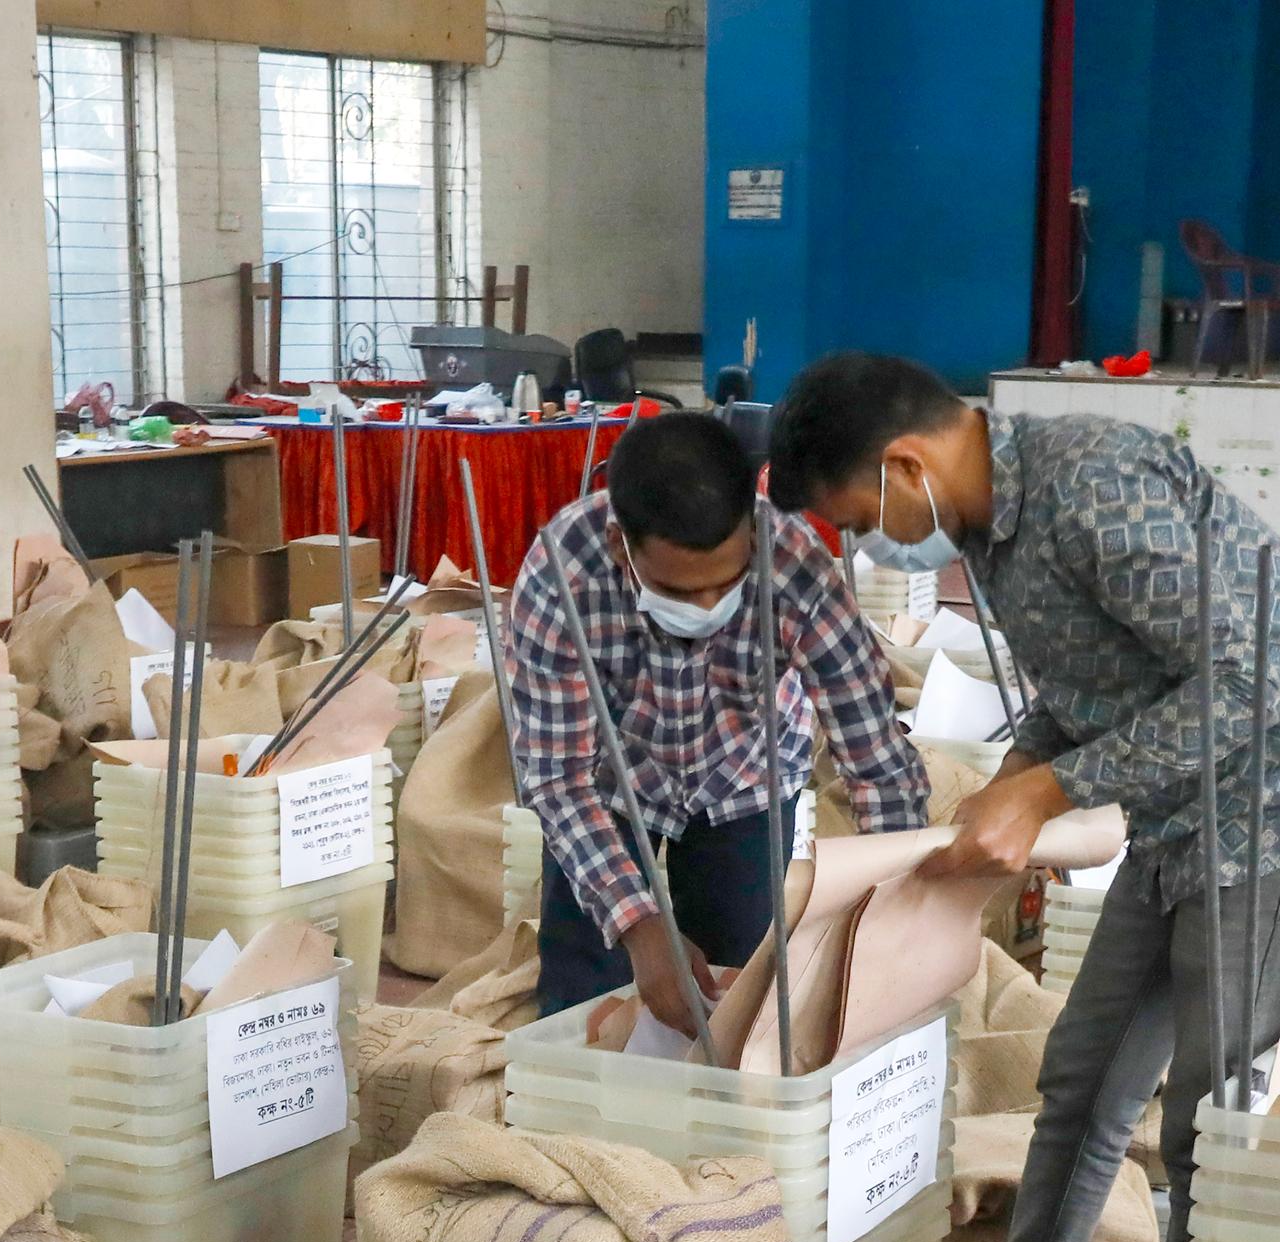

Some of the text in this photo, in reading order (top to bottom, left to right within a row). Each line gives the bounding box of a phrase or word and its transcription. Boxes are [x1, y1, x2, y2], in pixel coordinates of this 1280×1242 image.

[238, 1022, 256, 1038] কেন্দ্র
[258, 1015, 275, 1028] নম্বর
[257, 1105, 277, 1120] কক্ষ
[865, 1180, 886, 1205] কক্ষ
